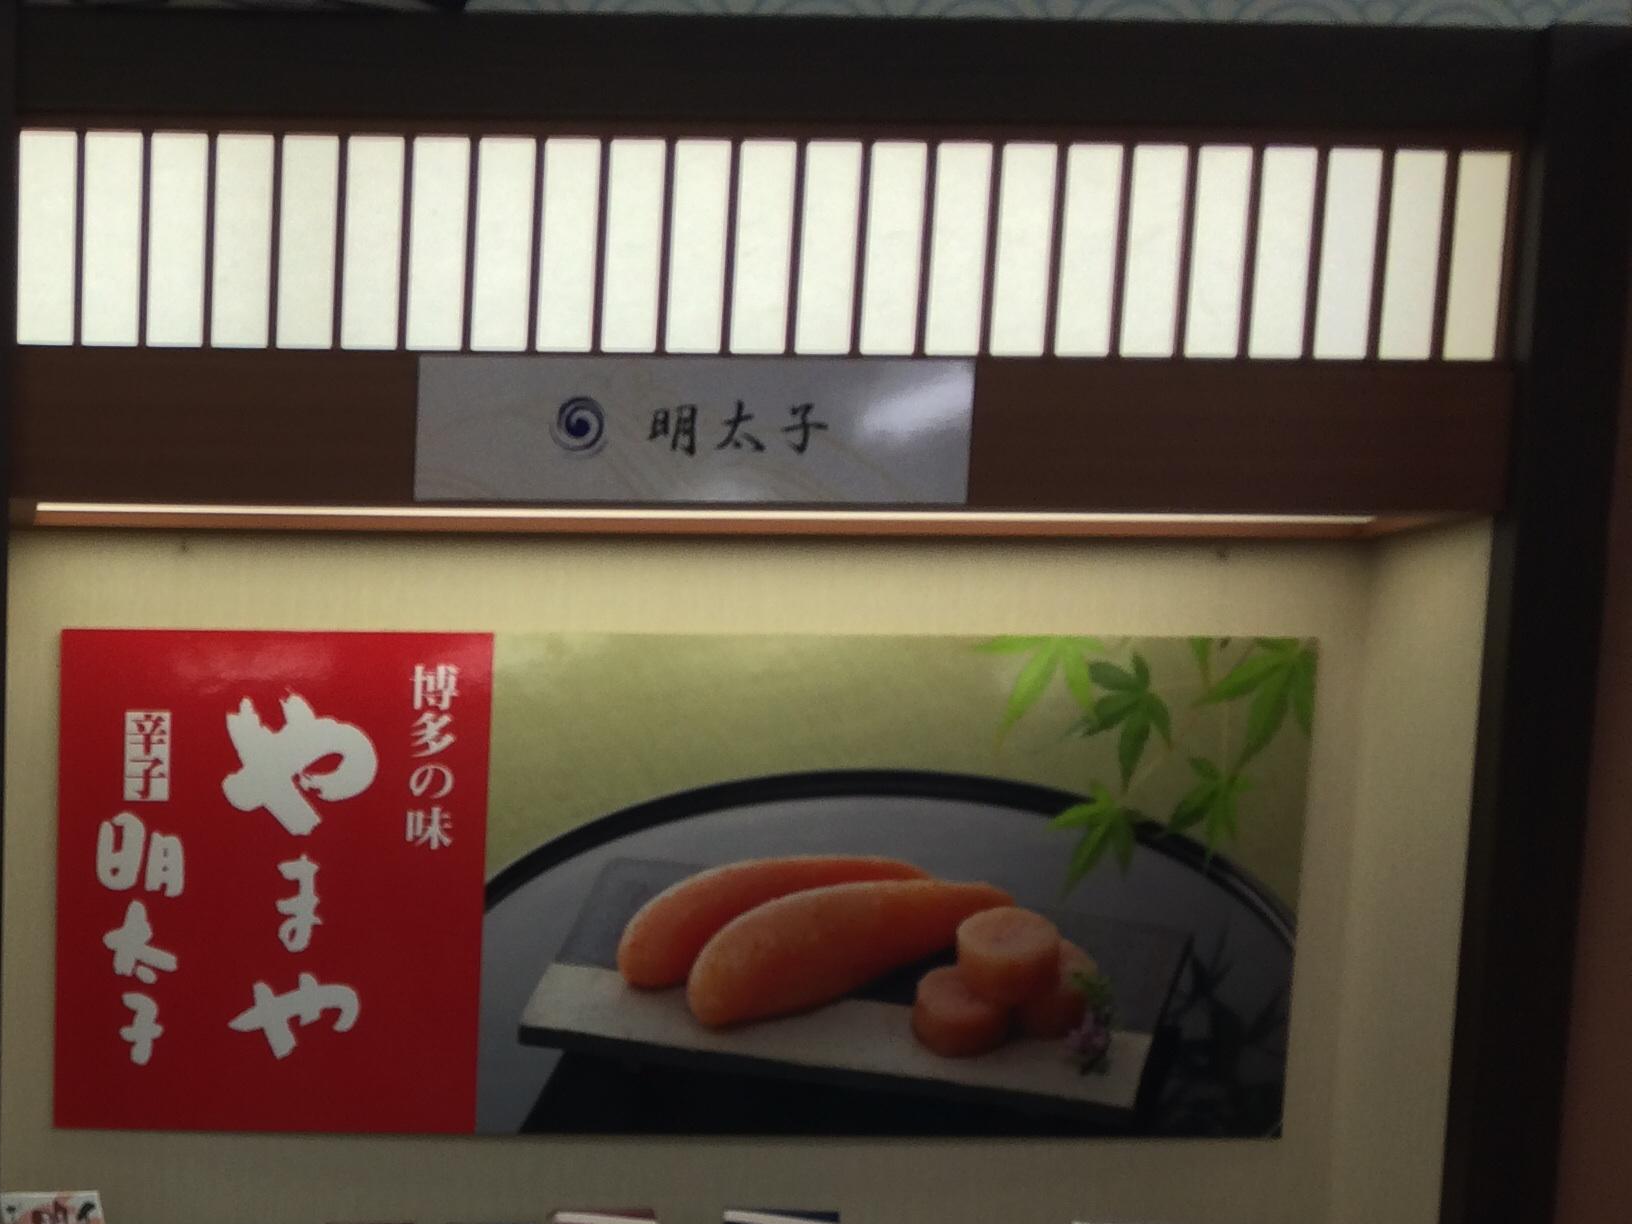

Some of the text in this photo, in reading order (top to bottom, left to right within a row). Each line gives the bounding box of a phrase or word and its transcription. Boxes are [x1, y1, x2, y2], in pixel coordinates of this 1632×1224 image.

[647, 400, 829, 455] 明太子
[405, 664, 460, 850] 博多の味
[222, 690, 378, 1060] やまや
